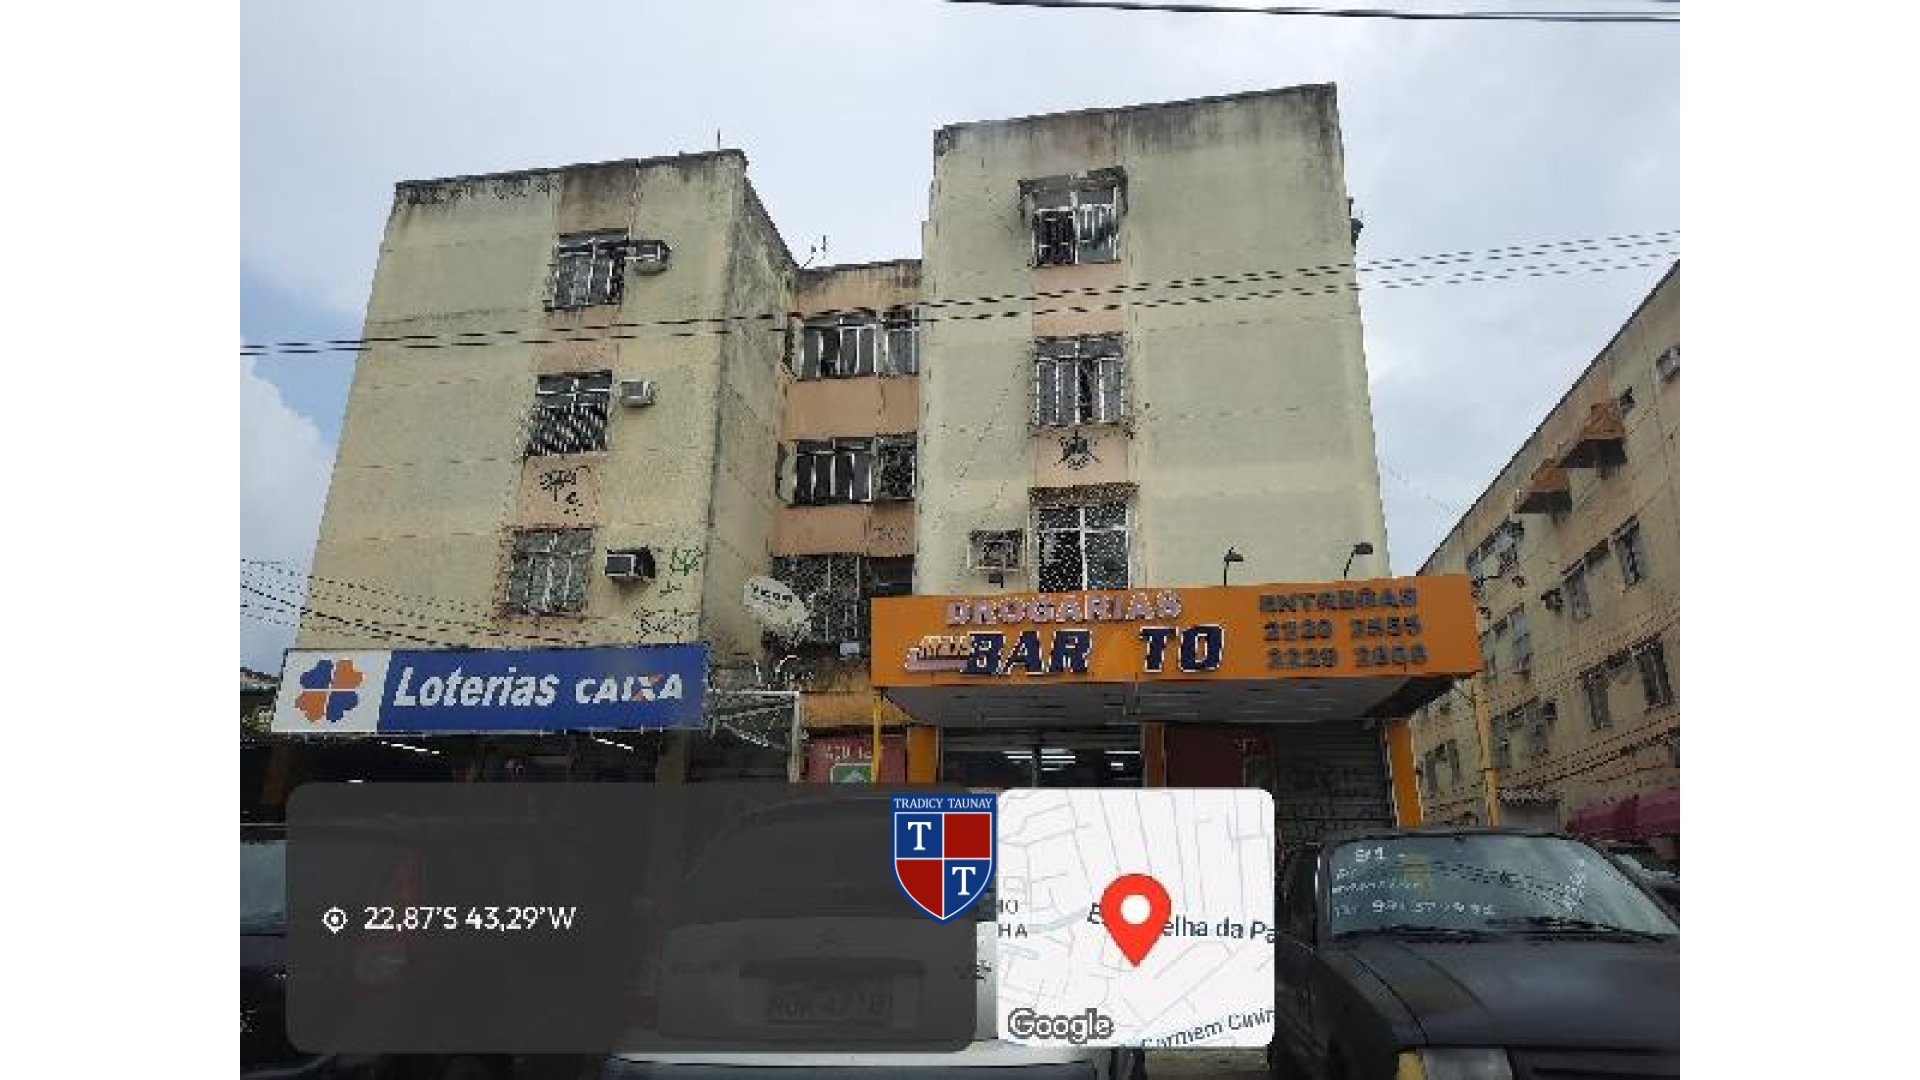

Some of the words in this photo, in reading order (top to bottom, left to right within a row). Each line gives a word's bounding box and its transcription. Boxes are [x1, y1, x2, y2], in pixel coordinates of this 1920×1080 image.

[947, 590, 1182, 624] DROGARIAS
[1260, 588, 1416, 612] ENTREGAS
[393, 666, 560, 706] Loterias
[575, 673, 683, 704] CAIXA
